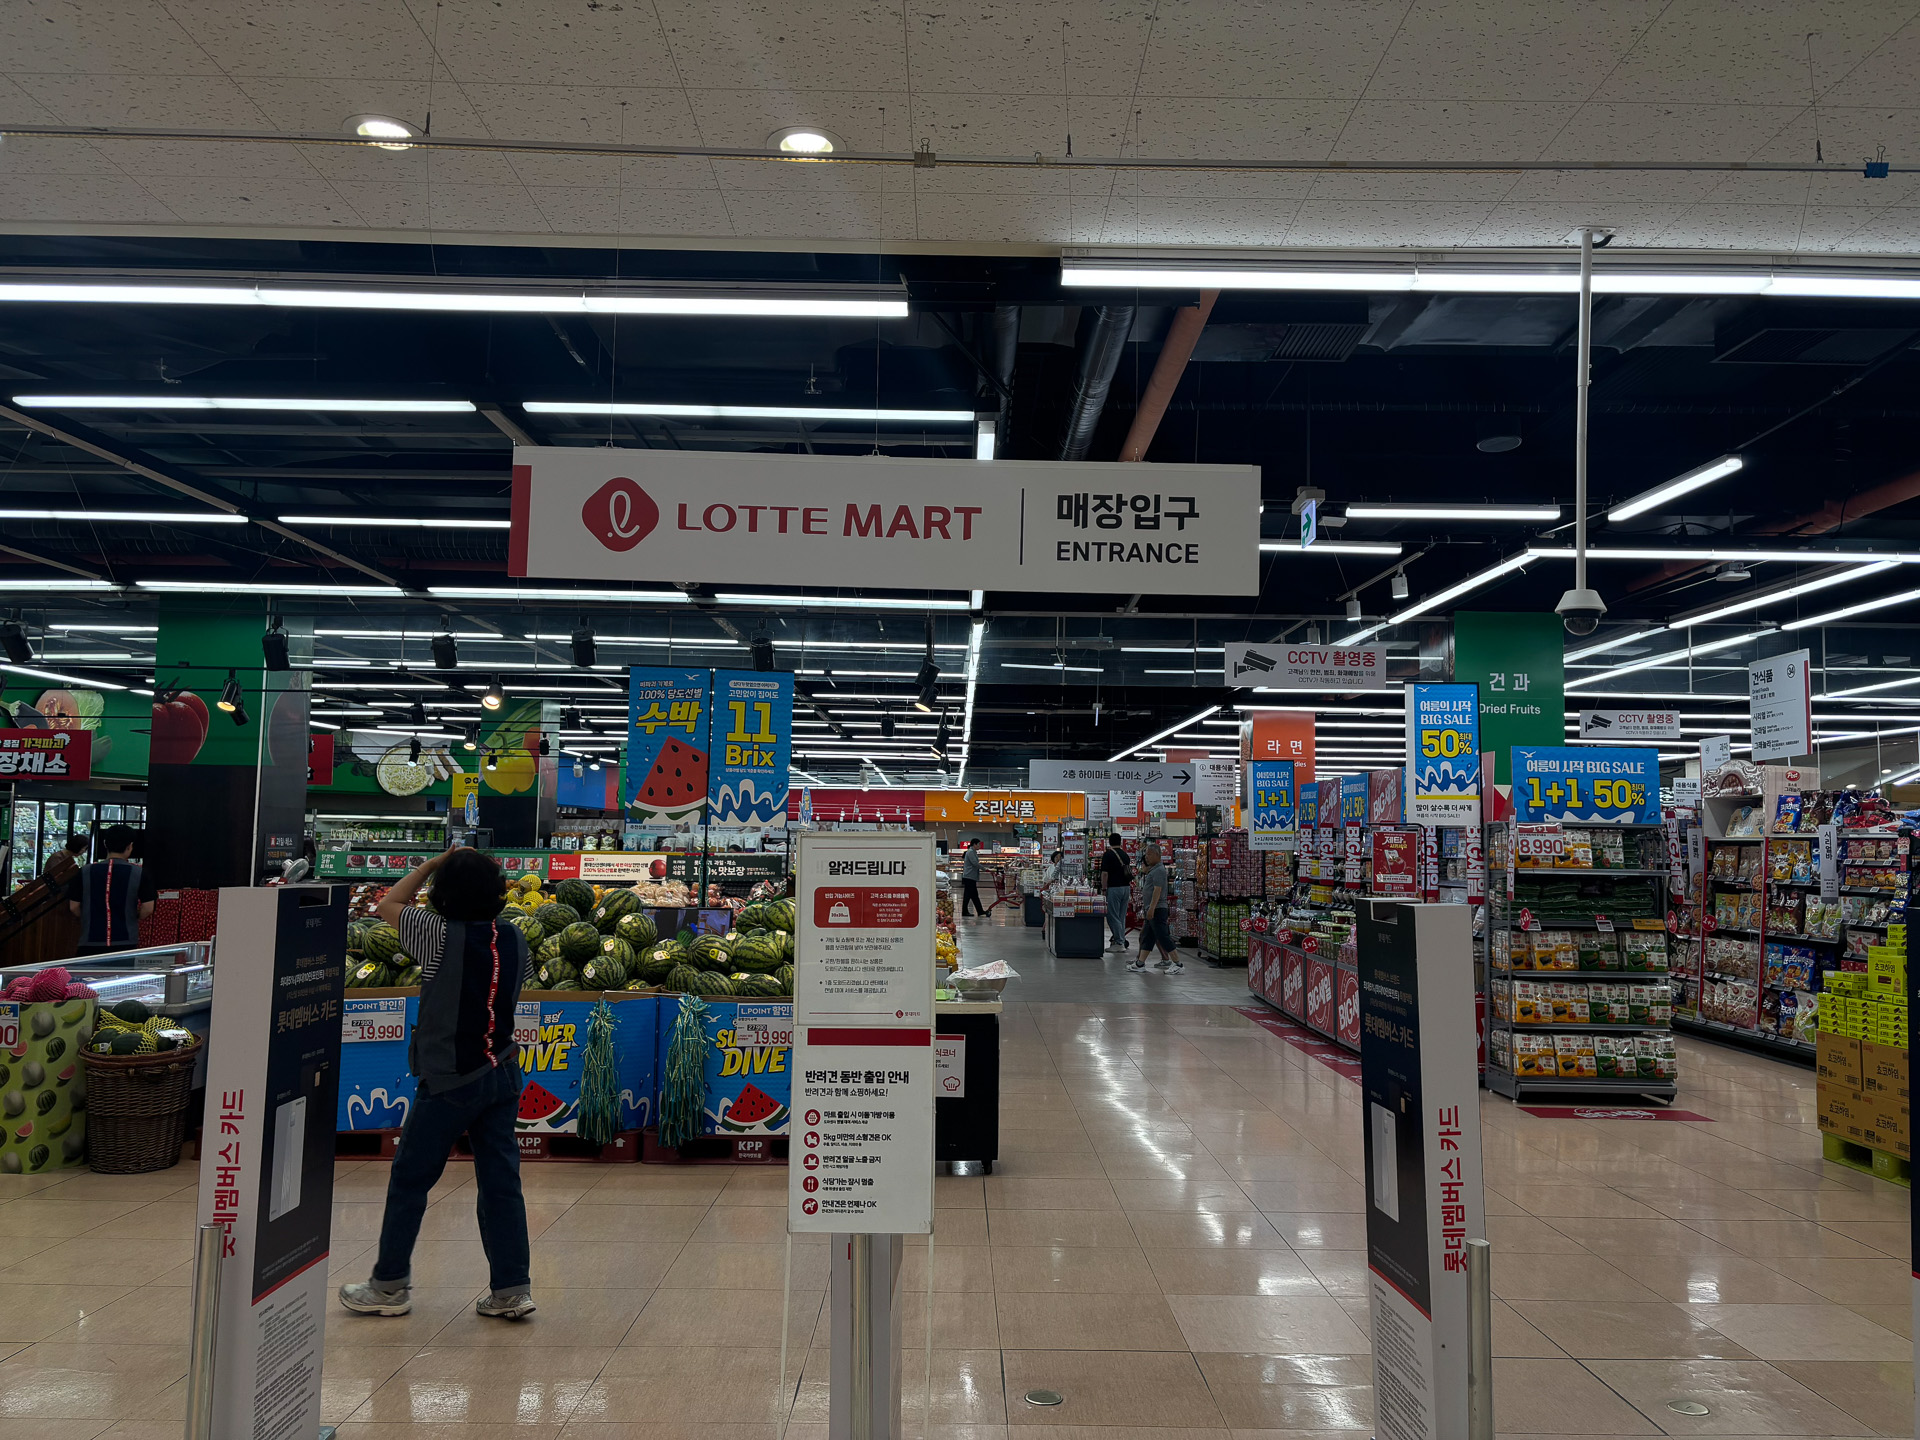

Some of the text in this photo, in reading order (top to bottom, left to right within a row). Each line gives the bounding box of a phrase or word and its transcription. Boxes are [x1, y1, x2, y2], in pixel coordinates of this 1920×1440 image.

[1056, 492, 1200, 532] 매장입구
[676, 502, 983, 541] LOTTE MART
[1055, 540, 1199, 565] ENTRANCE
[1288, 651, 1376, 667] CCTV 촬영중
[1752, 669, 1773, 686] 건식품
[1788, 667, 1795, 676] 34
[638, 688, 703, 700] 100% 당도선별
[728, 689, 779, 699] 고민없이 집어도
[1420, 700, 1472, 712] 여름의 시작
[1480, 703, 1541, 715] Dried Fruits
[635, 701, 703, 734] 수박
[726, 701, 777, 743] 11
[1420, 714, 1472, 725] BIG SALE
[1618, 713, 1674, 724] CCTV 촬영중
[1753, 711, 1766, 721] 시리얼
[22, 737, 66, 749] 가격파괴
[1421, 729, 1473, 758] 50%
[1459, 733, 1473, 741] 최대
[1754, 740, 1771, 750] 그래놀라
[725, 744, 775, 767] Brix
[1526, 760, 1645, 774] 여름의 시작 BIG SALE
[1062, 769, 1077, 779] 2층
[1078, 769, 1112, 780] 하이마트
[1256, 771, 1275, 779] 여름의
[1256, 780, 1289, 788] BIG SALE
[1631, 783, 1645, 792] 최대
[1257, 790, 1290, 808] 1+1
[1528, 777, 1645, 809] 1+1 50%
[973, 799, 1035, 818] 조리식품
[1458, 804, 1472, 812] 싸게
[1519, 838, 1563, 855] 8,990
[1823, 830, 1833, 861] 시리얼바
[1320, 827, 1334, 880] BIG세일
[1346, 826, 1360, 883] BIG세일
[718, 866, 746, 876] 맛보장
[828, 860, 906, 876] 알려드립니다
[1255, 921, 1266, 929] 1+1
[1704, 919, 1716, 929] 1+1
[1303, 940, 1317, 949] 1+1
[1874, 962, 1896, 974] 초코하임
[1283, 962, 1303, 1001] BIG세일
[1307, 972, 1332, 1016] BIG세일
[345, 1000, 397, 1011] L.POINT 할인
[740, 1006, 790, 1016] L.POINT 할인
[277, 999, 338, 1034] 롯데멤버스 카드
[358, 1025, 403, 1040] 19,990
[1364, 1012, 1398, 1043] 롯데멤버스
[1398, 1027, 1415, 1048] 카드
[754, 1030, 793, 1045] 19,990
[519, 1042, 569, 1074] DIVE
[718, 1046, 788, 1077] DIVE
[1827, 1052, 1847, 1067] 초코하임
[805, 1070, 910, 1084] 반려견 동반 출입 안내
[1876, 1064, 1899, 1080] 초코하임
[804, 1087, 889, 1097] 반려견과 함께 쇼핑하세요!
[220, 1088, 245, 1137] 카드
[1829, 1102, 1850, 1118] 초코하임
[1875, 1117, 1898, 1133] 초코하임
[519, 1138, 542, 1147] KPP
[836, 1133, 855, 1141] 미만의
[881, 1133, 892, 1141] OK
[738, 1141, 763, 1151] KPP
[822, 1178, 847, 1186] 식당가는
[847, 1178, 861, 1186] 잠시
[1438, 1105, 1467, 1274] 카드 롯데멤버스
[821, 1200, 847, 1208] 안내견은
[847, 1200, 866, 1208] 언제나
